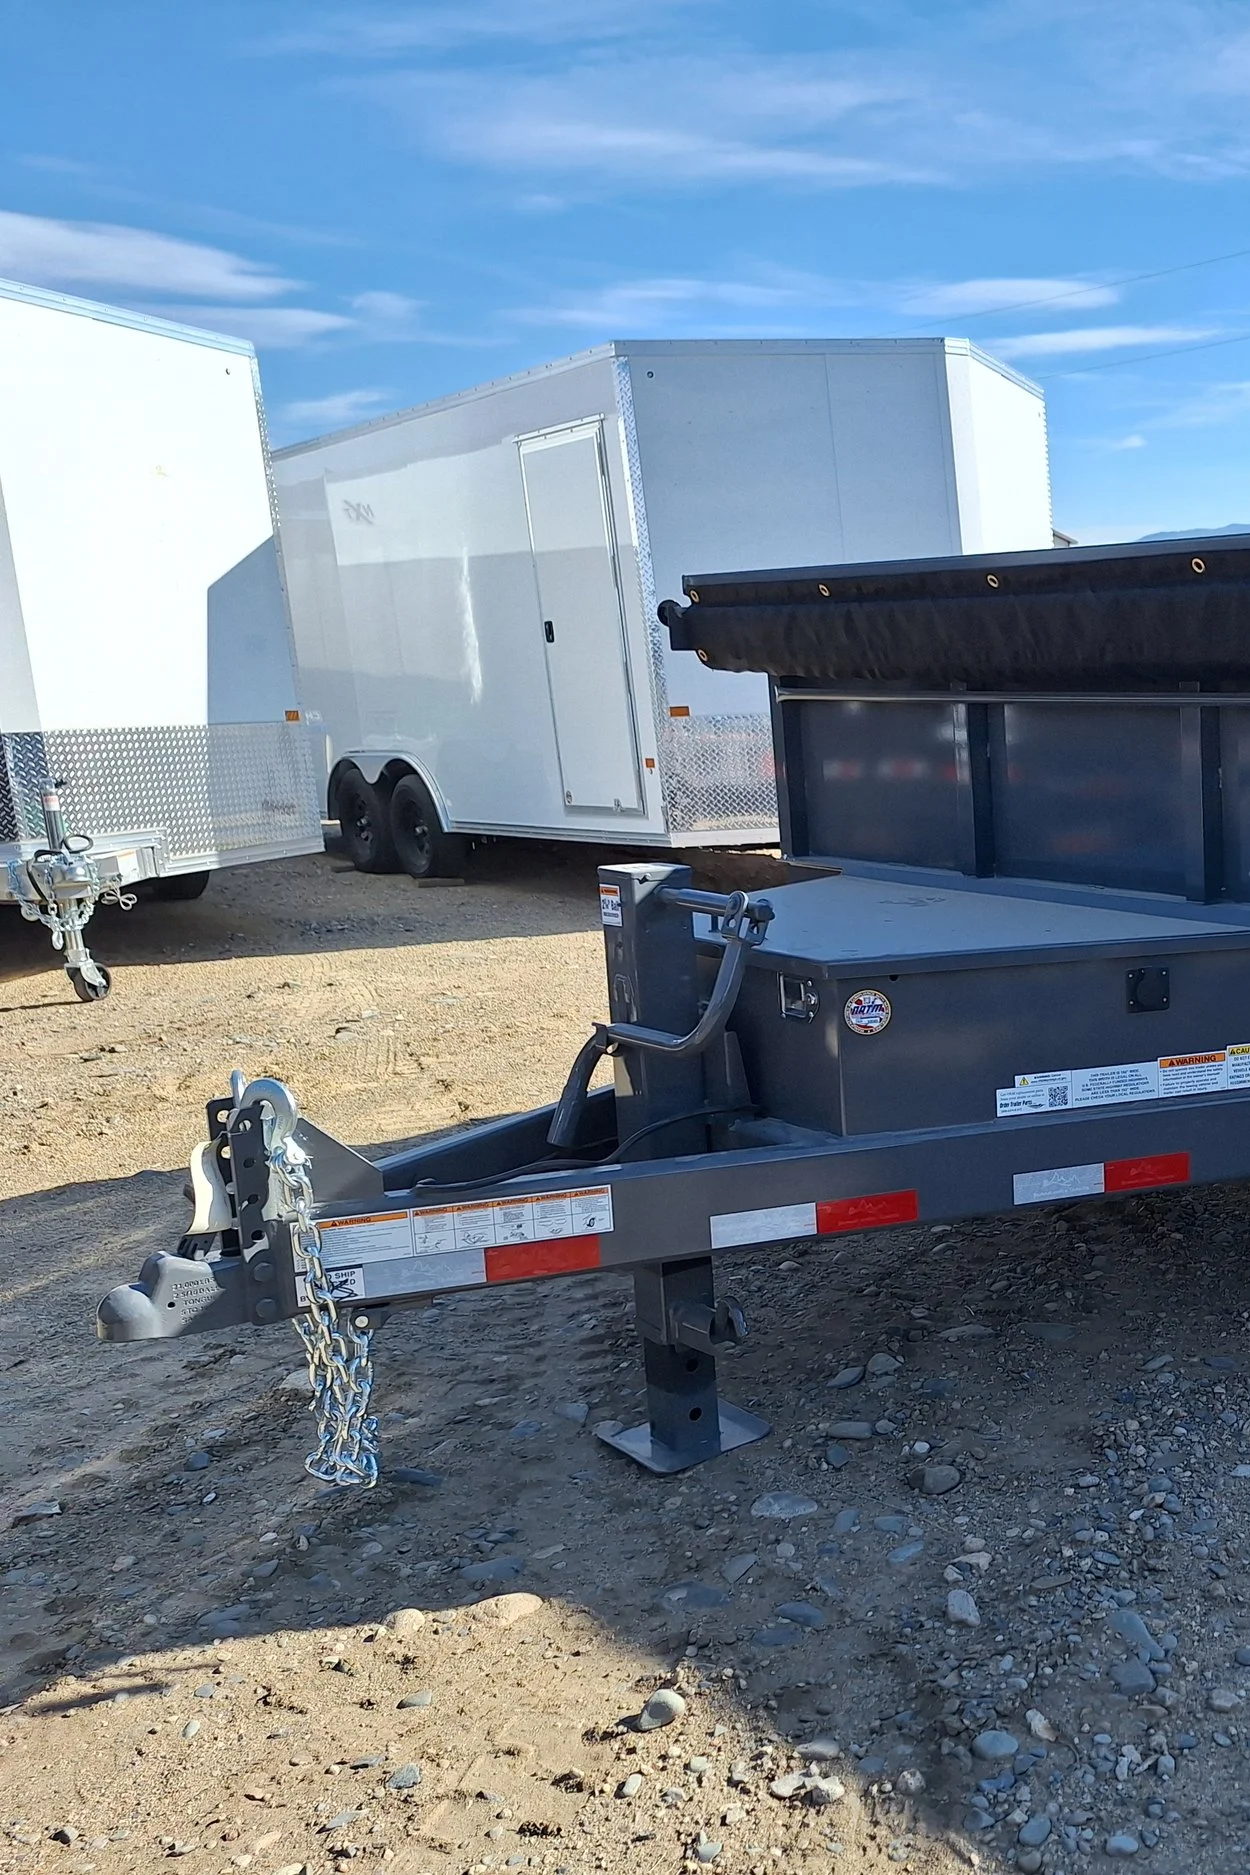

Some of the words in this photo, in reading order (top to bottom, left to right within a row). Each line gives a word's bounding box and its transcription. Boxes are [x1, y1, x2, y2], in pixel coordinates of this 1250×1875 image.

[1176, 1055, 1217, 1066] WARNING
[337, 1217, 372, 1226] WARNING
[335, 1270, 356, 1280] SHIP
